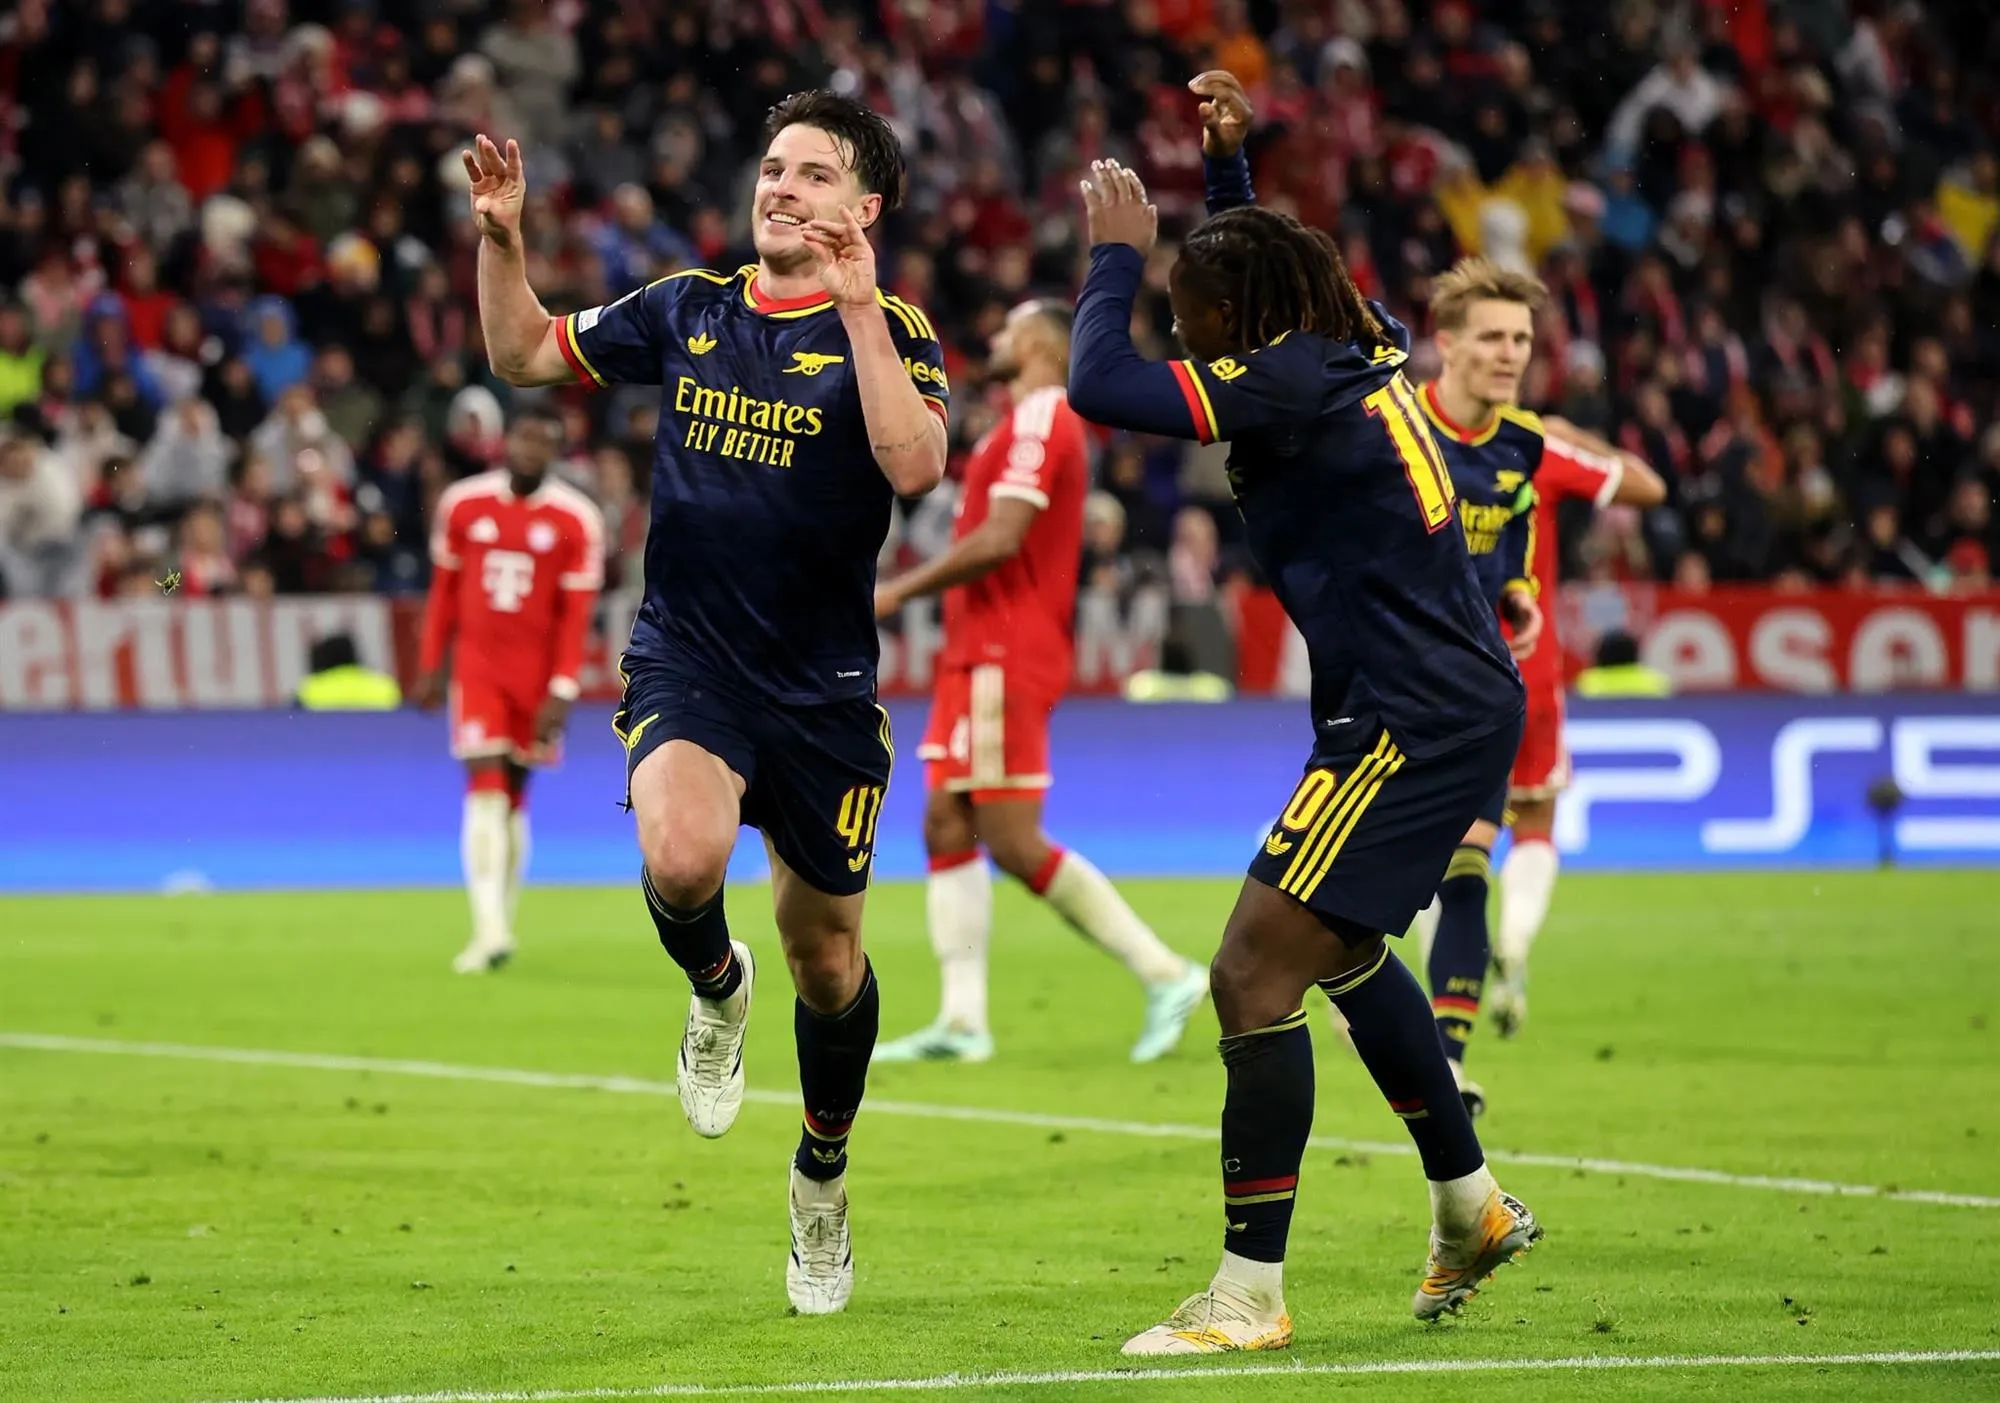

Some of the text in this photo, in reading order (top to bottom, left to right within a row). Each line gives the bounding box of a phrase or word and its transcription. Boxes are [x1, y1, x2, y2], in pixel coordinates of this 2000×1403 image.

[675, 376, 823, 436] Emirates
[684, 420, 795, 468] FLY BETTER
[1555, 716, 2000, 853] PS5
[836, 785, 883, 848] 41
